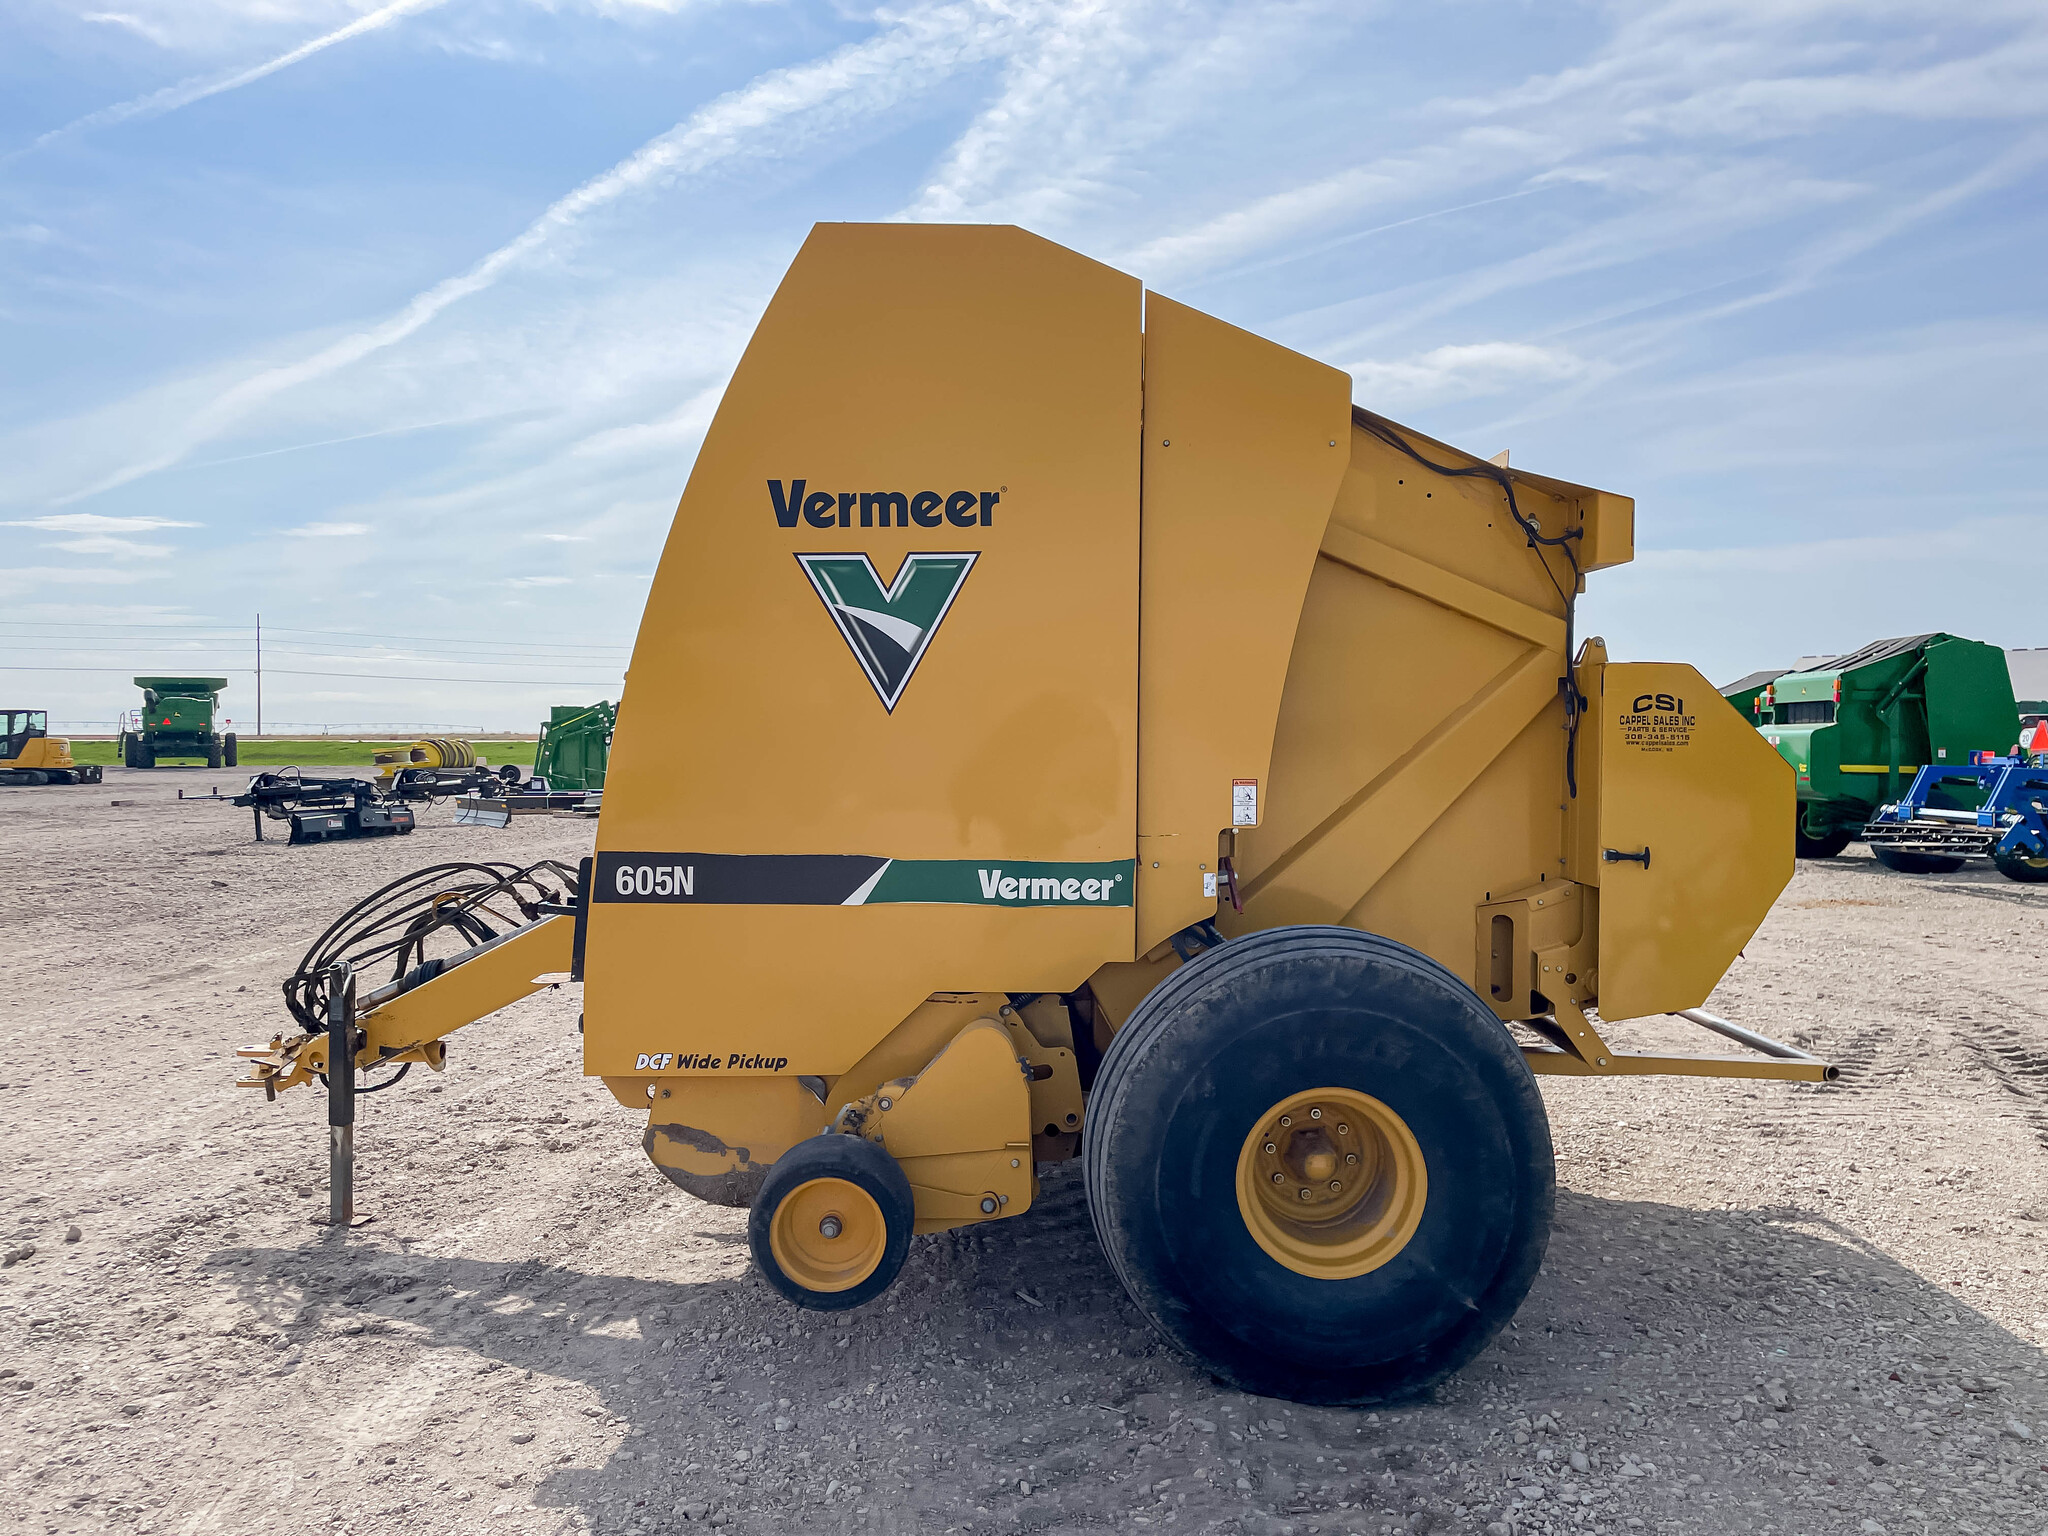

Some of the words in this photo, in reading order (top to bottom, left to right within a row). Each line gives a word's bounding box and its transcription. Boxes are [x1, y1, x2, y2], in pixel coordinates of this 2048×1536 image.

[767, 479, 1000, 529] Vermeer
[1632, 693, 1684, 715] CSI
[1619, 715, 1651, 725] CAPPEL
[1653, 715, 1680, 726] SALES
[1681, 716, 1695, 726] INC
[615, 865, 694, 896] 605N
[977, 869, 1114, 901] Vermeer
[634, 1053, 673, 1070] DCF
[677, 1053, 722, 1069] Wide
[727, 1053, 788, 1072] Pickup
